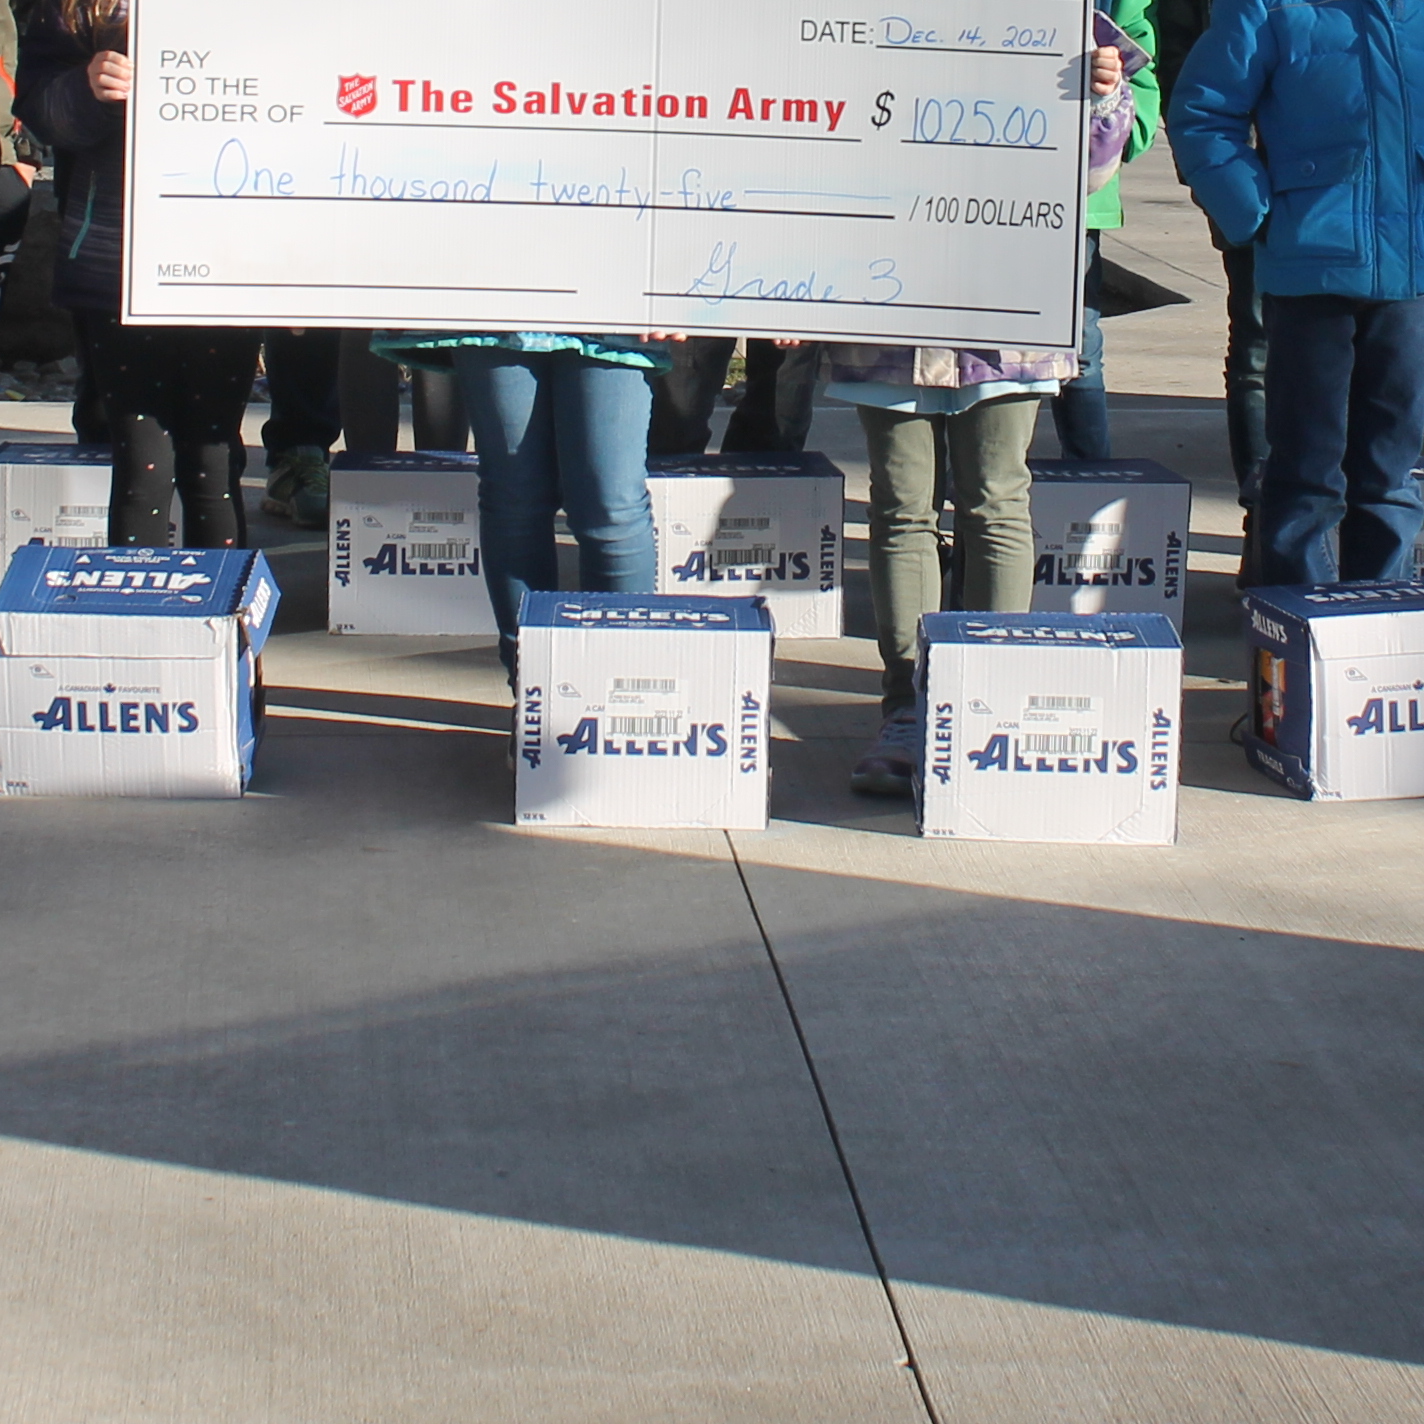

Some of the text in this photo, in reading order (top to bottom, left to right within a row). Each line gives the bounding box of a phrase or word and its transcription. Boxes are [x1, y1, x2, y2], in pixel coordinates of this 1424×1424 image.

[800, 19, 874, 44] DATE:
[1001, 25, 1056, 48] 2021
[160, 50, 211, 68] PAY
[159, 76, 260, 96] TO THE
[339, 80, 373, 108] SALVATION
[345, 78, 360, 92] THE
[159, 102, 304, 123] ORDER OF
[351, 92, 373, 113] ARMY
[392, 79, 846, 131] The Salvation Army
[871, 90, 895, 130] $
[213, 137, 737, 221] One thousand twenty-five
[965, 198, 1065, 229] DOLLARS
[157, 264, 211, 278] MEMO
[685, 241, 903, 306] Grade 3
[335, 518, 350, 587] ALLEN'S
[820, 524, 836, 592] ALLEN'S
[1164, 531, 1182, 599] ALLEN'S
[45, 570, 212, 591] ALLEN'S
[1377, 684, 1411, 693] CANADIAN
[32, 697, 199, 733] ALLEN'S
[522, 685, 542, 769] ALLEN'S
[740, 691, 760, 774] ALLEN'S
[931, 703, 953, 785] ALLEN'S
[1150, 708, 1172, 791] ALLEN'S
